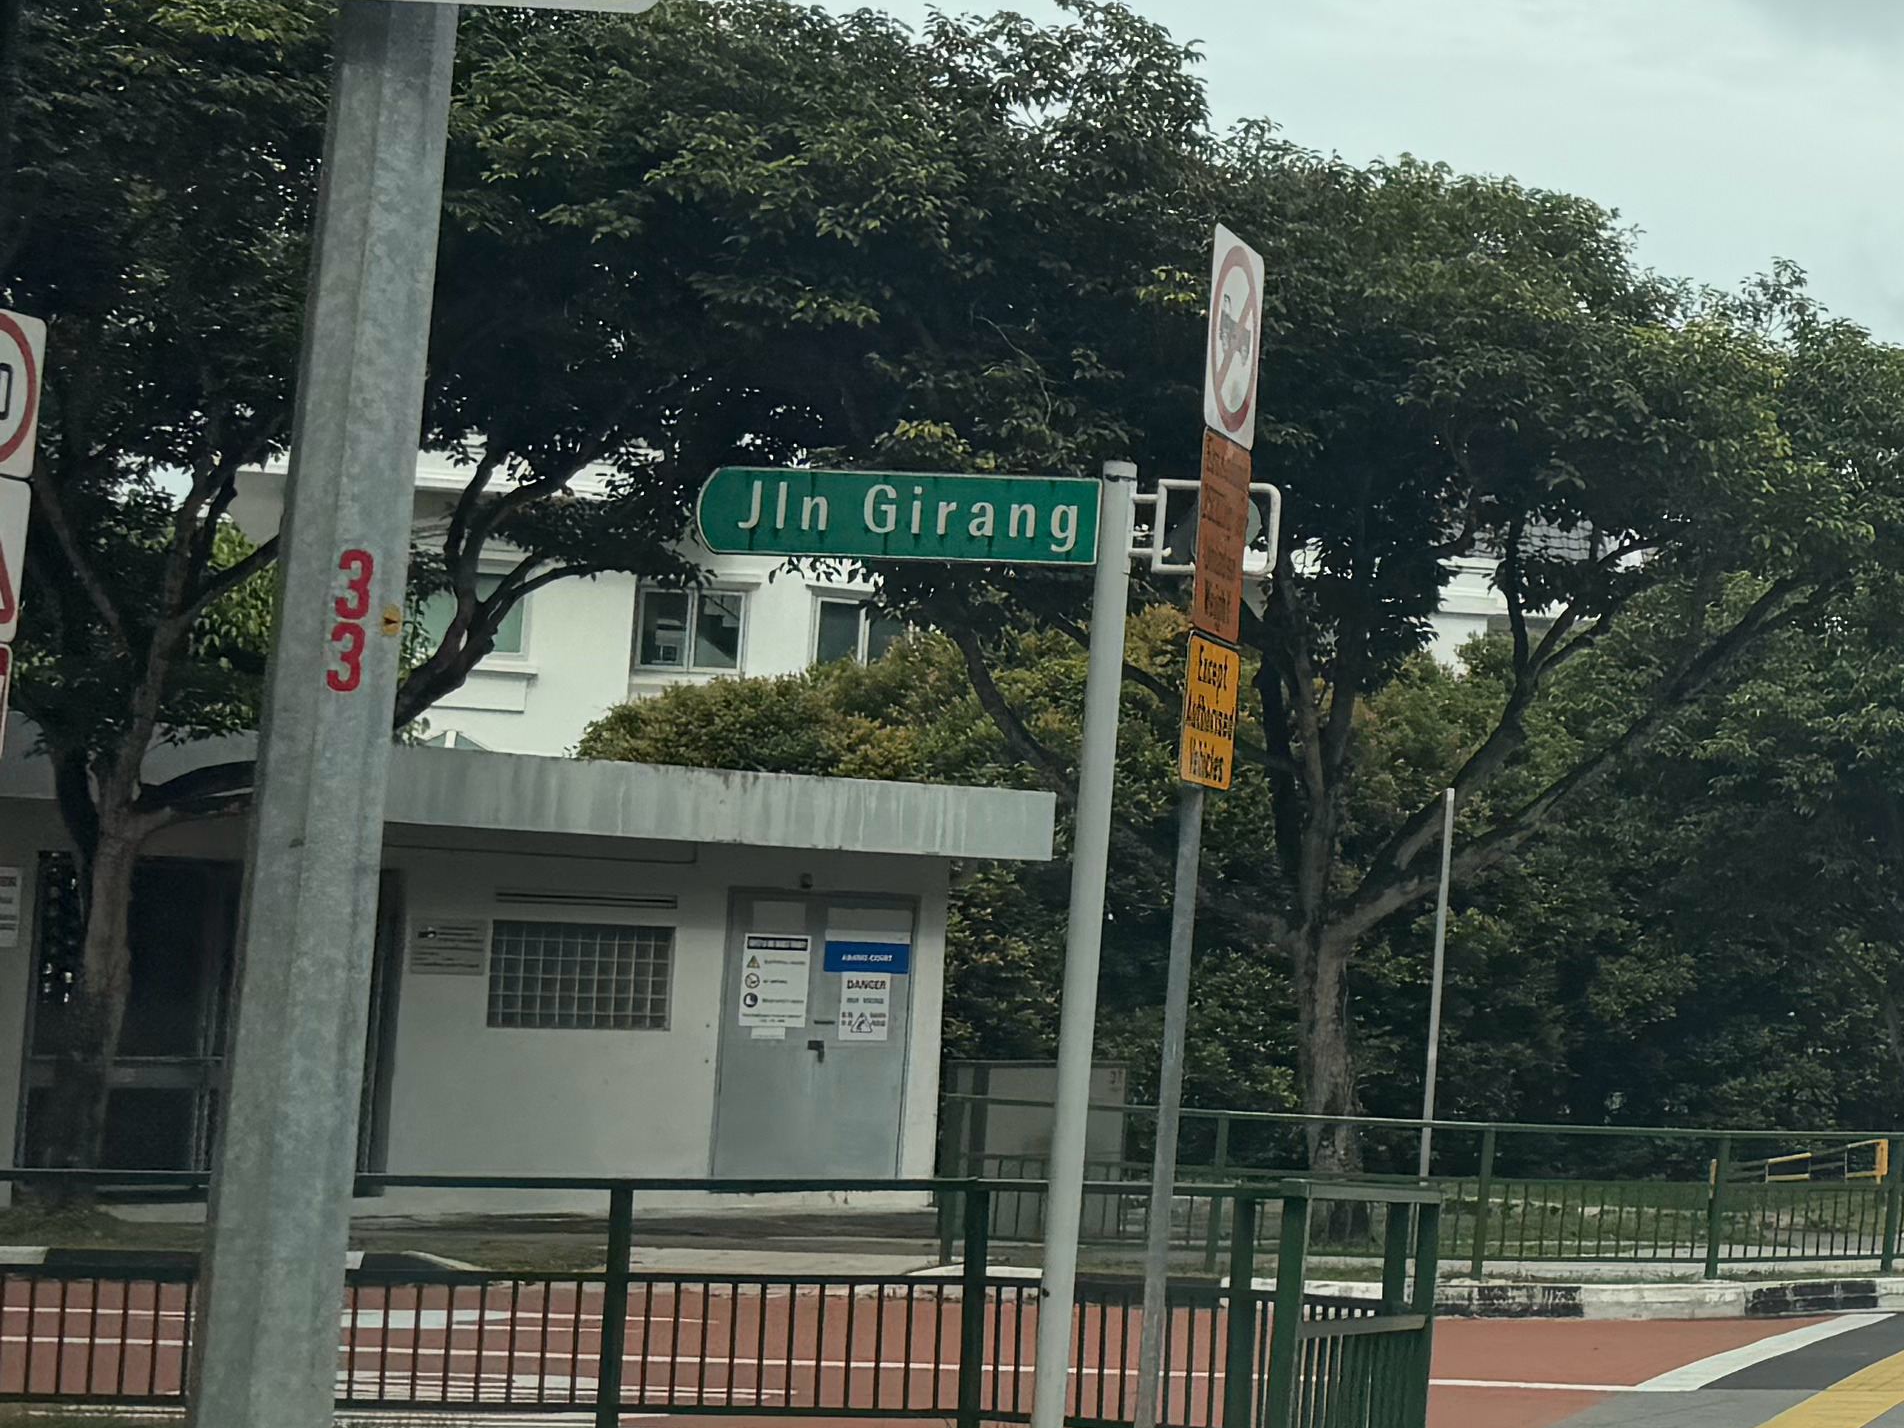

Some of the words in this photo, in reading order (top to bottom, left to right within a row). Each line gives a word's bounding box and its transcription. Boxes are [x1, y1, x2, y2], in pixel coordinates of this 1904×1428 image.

[738, 480, 828, 531] Jln
[863, 484, 1079, 553] Girang
[1198, 645, 1228, 705] Except
